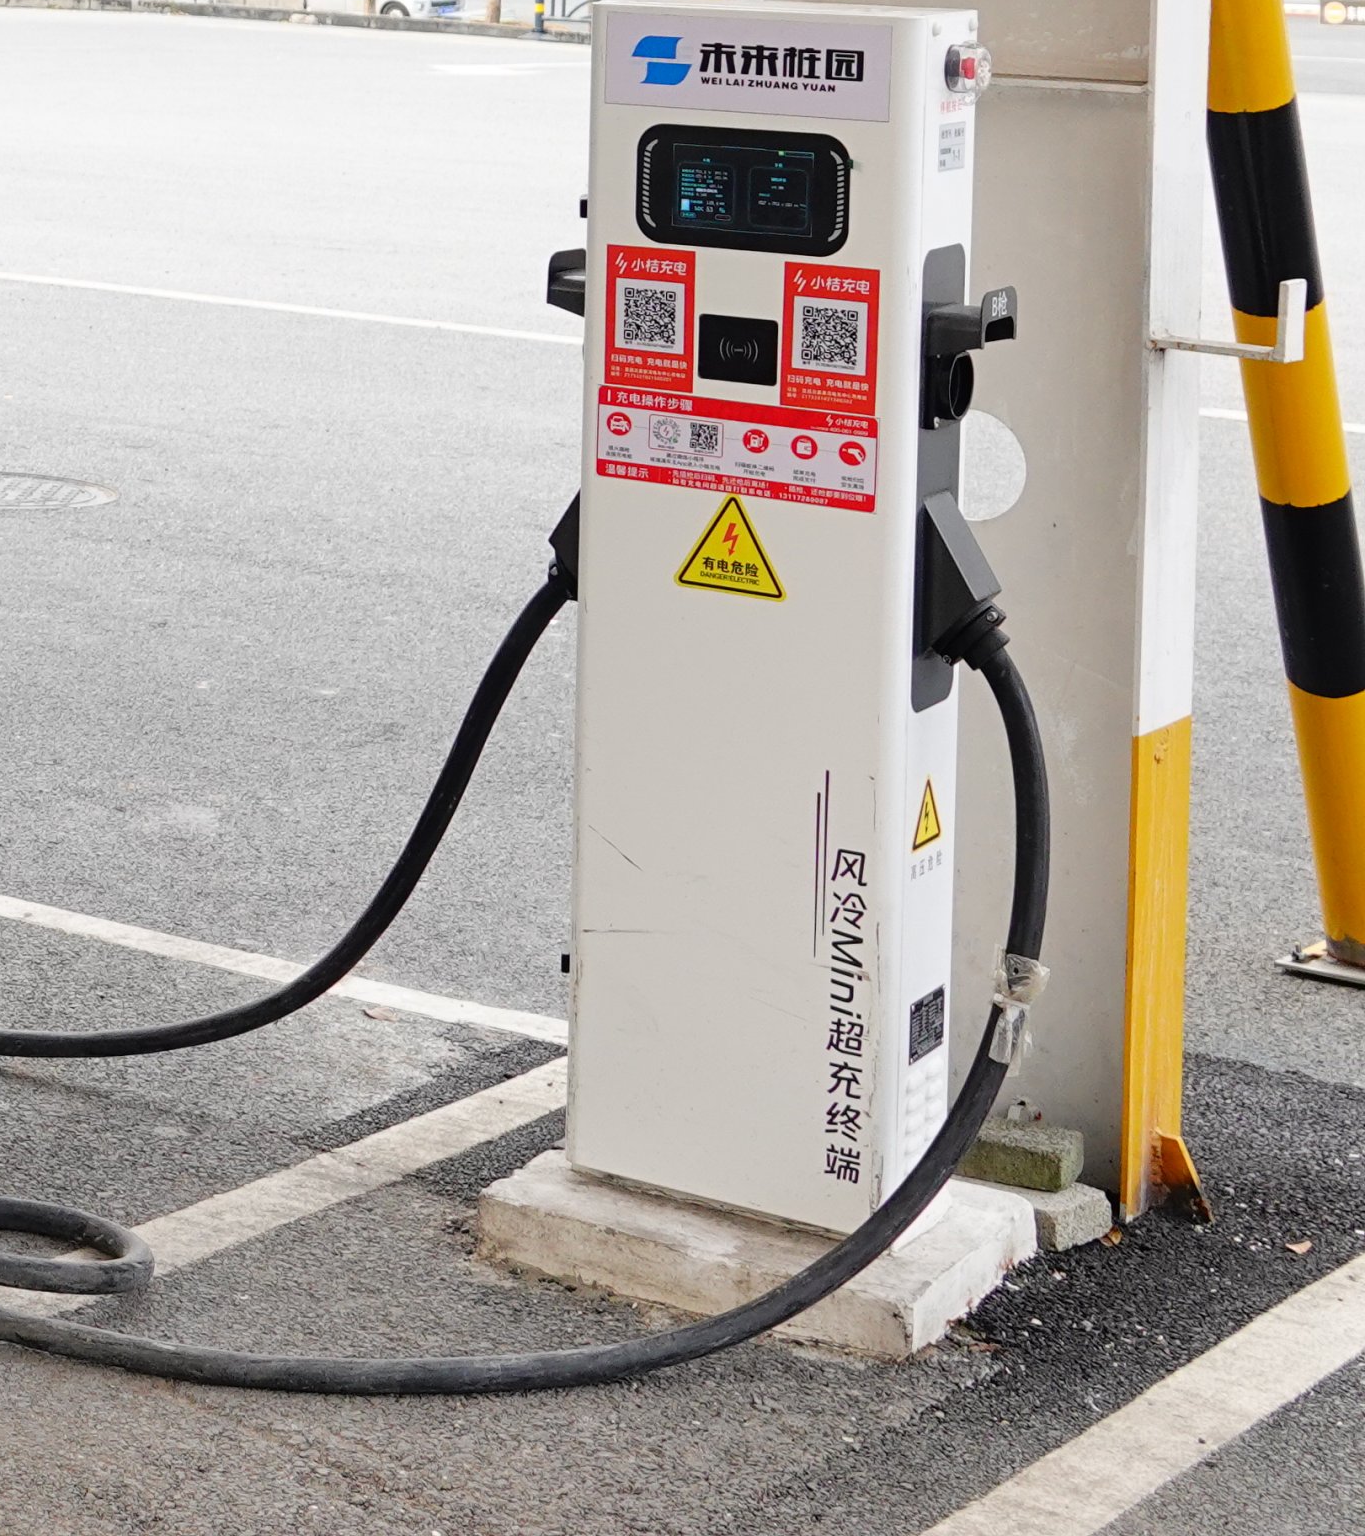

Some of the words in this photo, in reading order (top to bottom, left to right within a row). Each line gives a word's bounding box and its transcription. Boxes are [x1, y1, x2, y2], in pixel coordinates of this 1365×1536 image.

[699, 42, 865, 82] 未来桩园
[700, 76, 723, 87] WEI
[725, 78, 745, 88] LAI
[747, 79, 799, 91] ZHUANG
[802, 82, 836, 93] YUAN
[631, 258, 687, 276] 小桔充电
[810, 275, 870, 295] 小桔充电
[991, 290, 1008, 317] B枪
[616, 391, 693, 411] 充电操作步骤
[835, 418, 869, 429] 小桔充电
[605, 463, 649, 479] 温馨提示
[702, 556, 760, 578] 有电危险
[824, 849, 868, 1184] 风冷Mini超充终端
